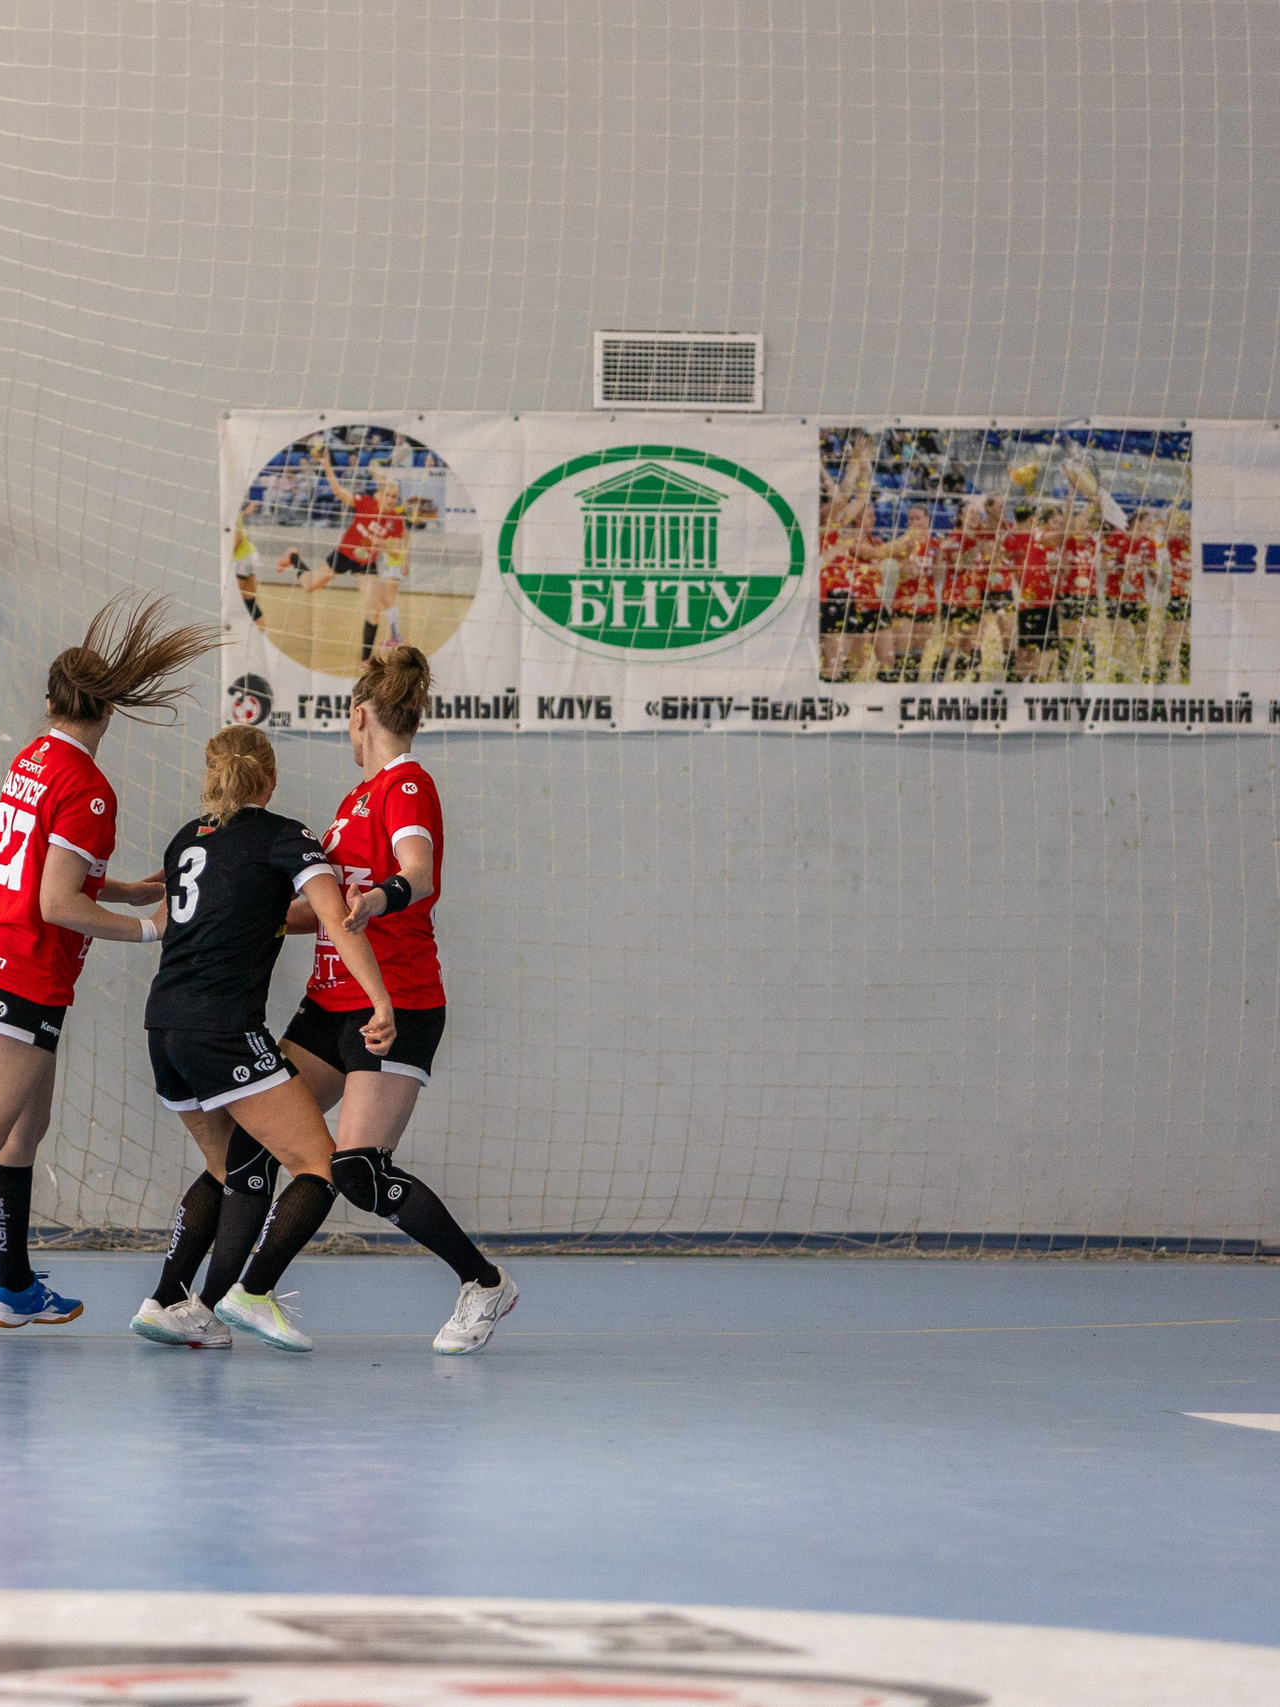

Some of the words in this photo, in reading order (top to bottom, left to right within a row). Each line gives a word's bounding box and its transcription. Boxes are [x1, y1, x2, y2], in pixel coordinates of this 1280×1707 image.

[568, 579, 748, 629] БНТУ
[537, 695, 613, 720] КЛУБ
[900, 688, 1007, 721] САМЫЙ
[1023, 691, 1252, 723] ТИТУЛОВАННЫЙ
[171, 846, 207, 923] 3
[166, 1204, 186, 1260] Kempa
